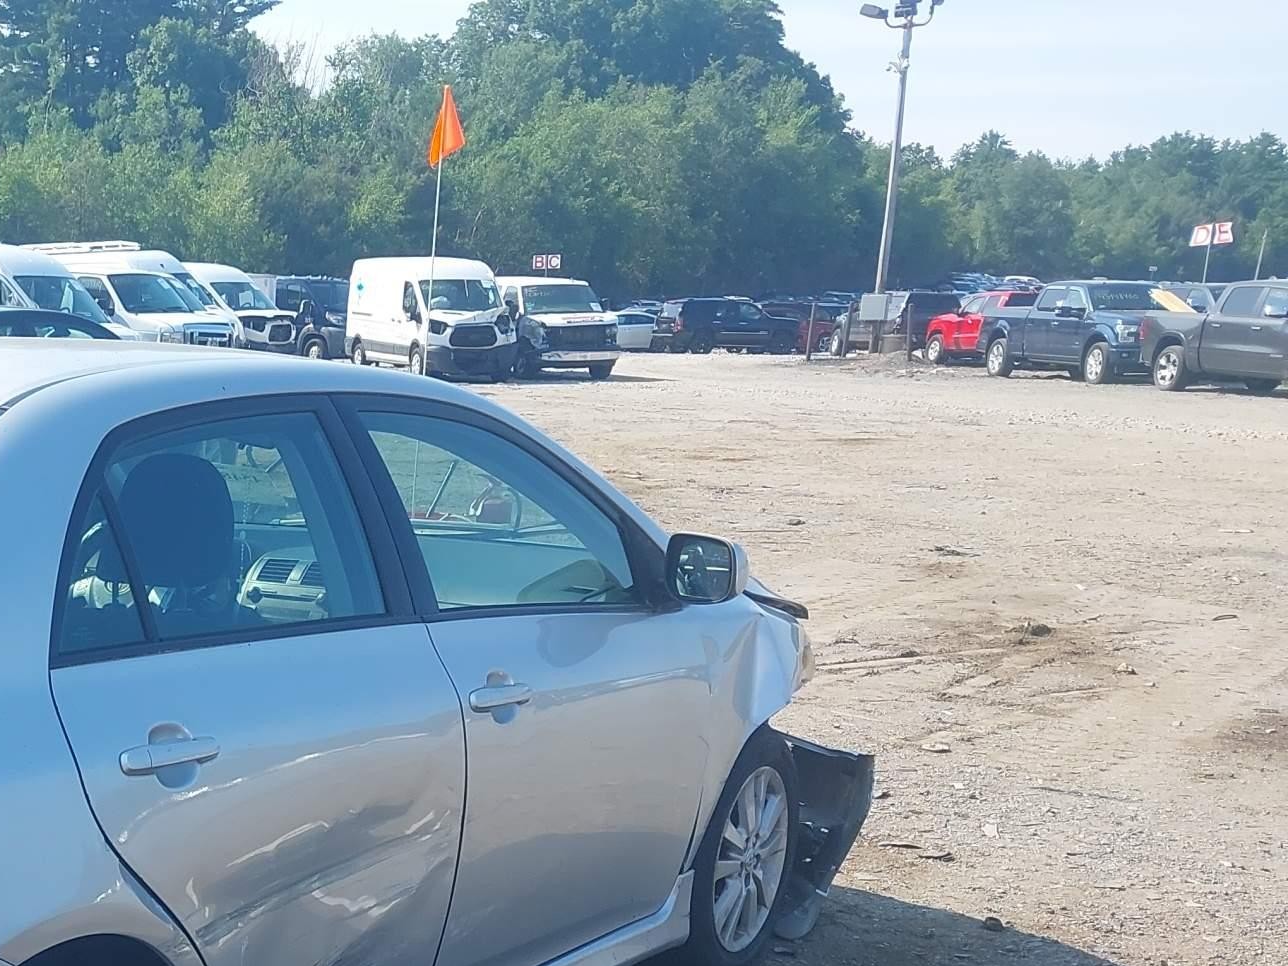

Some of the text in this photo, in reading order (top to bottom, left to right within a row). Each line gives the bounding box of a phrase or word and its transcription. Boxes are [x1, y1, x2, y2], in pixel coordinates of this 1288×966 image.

[1193, 226, 1210, 245] D
[535, 255, 560, 269] B C
